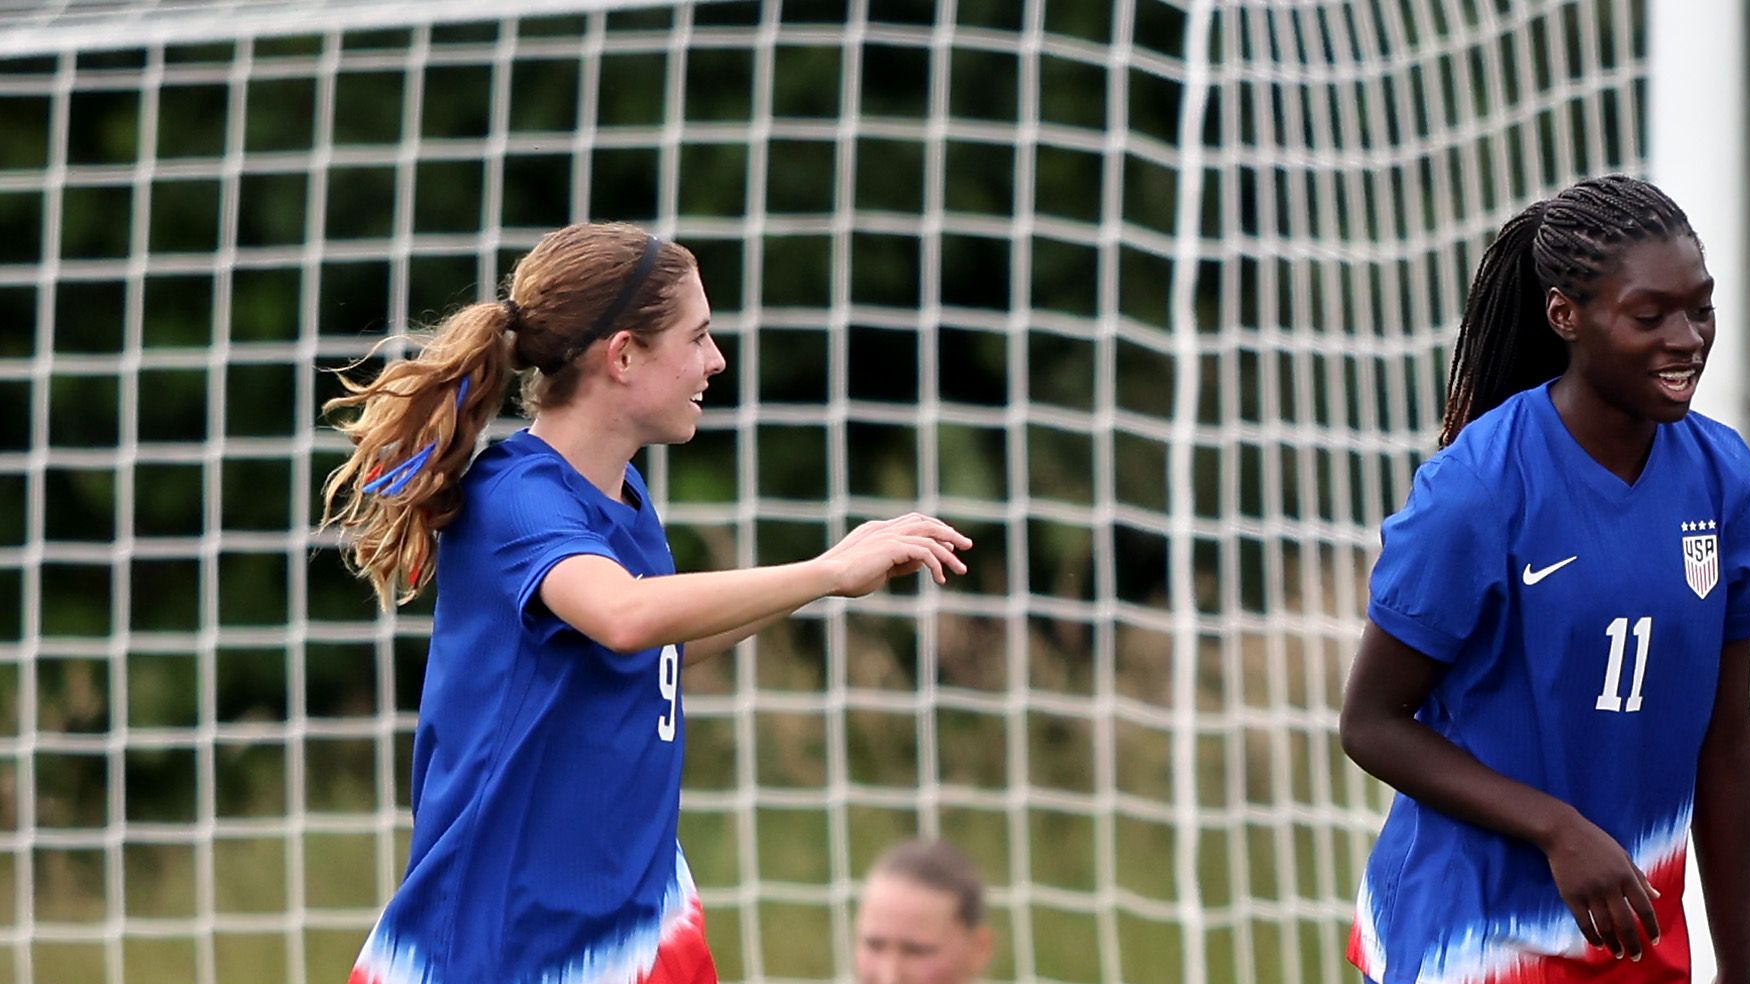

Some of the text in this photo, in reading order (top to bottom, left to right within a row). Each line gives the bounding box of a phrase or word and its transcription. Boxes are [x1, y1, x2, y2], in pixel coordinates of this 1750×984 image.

[1685, 538, 1715, 563] USA
[658, 643, 679, 742] 9
[1595, 616, 1652, 713] 11
